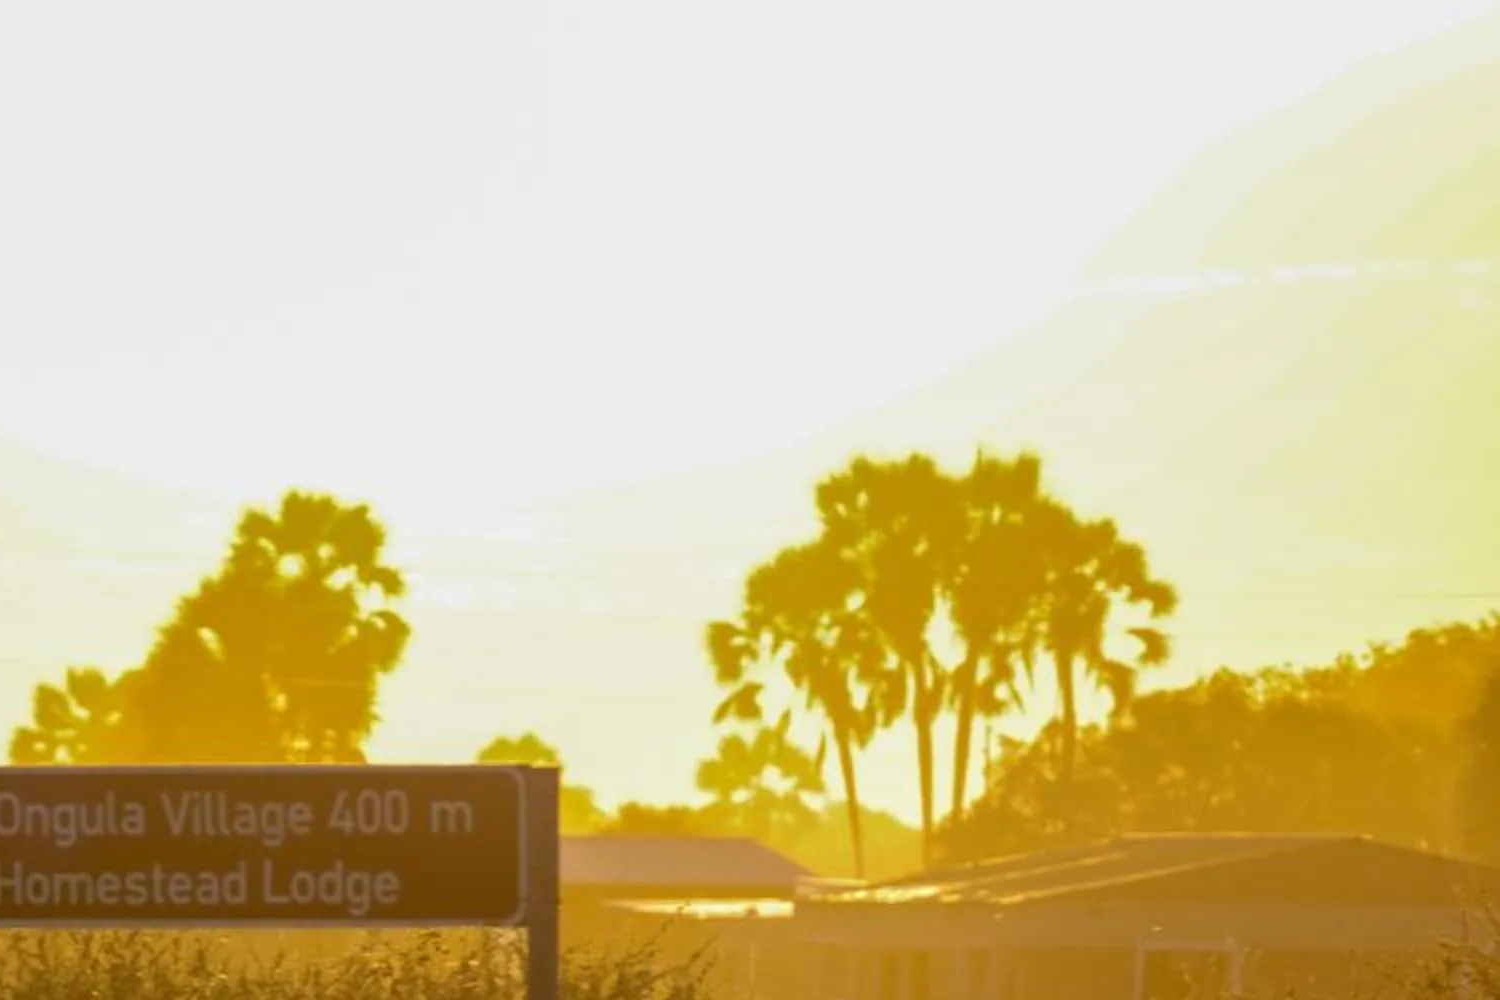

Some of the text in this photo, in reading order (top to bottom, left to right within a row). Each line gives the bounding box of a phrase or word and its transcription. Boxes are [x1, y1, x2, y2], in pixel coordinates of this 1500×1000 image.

[161, 790, 313, 847] Village
[328, 789, 410, 834] 400
[429, 799, 473, 833] m
[262, 861, 399, 915] Lodge
